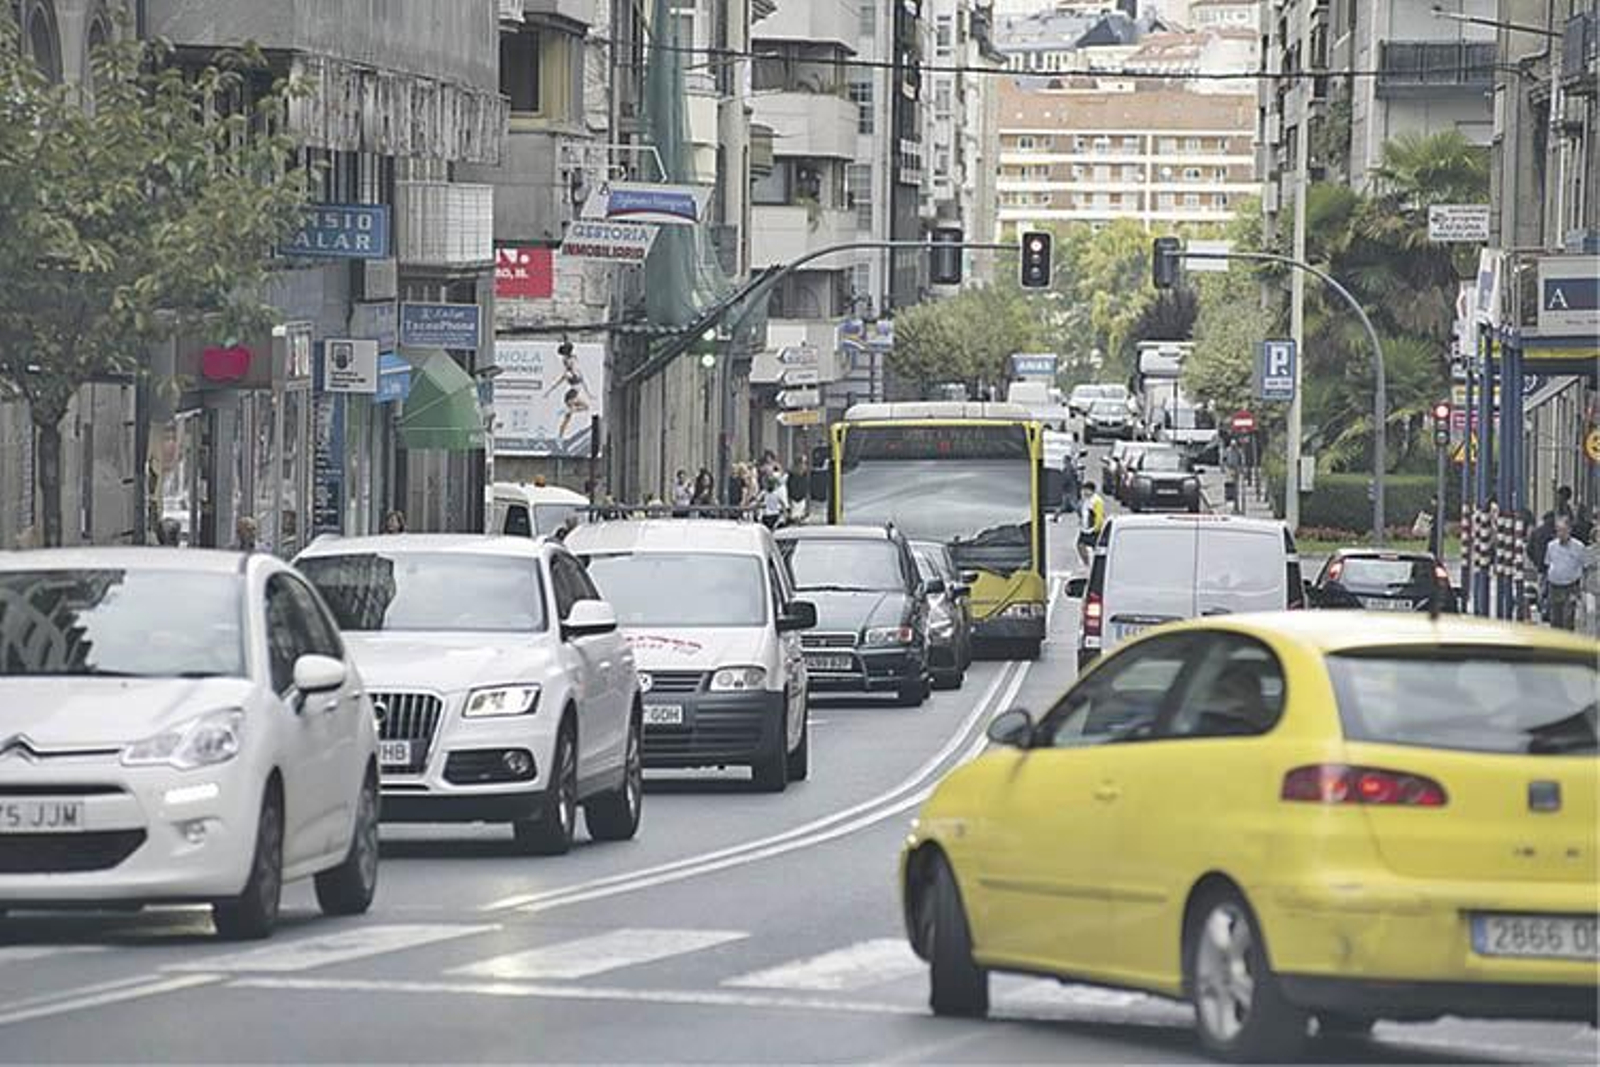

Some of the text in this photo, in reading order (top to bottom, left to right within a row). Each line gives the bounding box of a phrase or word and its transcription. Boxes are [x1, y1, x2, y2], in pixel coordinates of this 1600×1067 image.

[572, 224, 648, 242] GESTORIA
[1548, 288, 1568, 309] A
[30, 802, 77, 827] JJM
[1494, 919, 1564, 951] 2866
